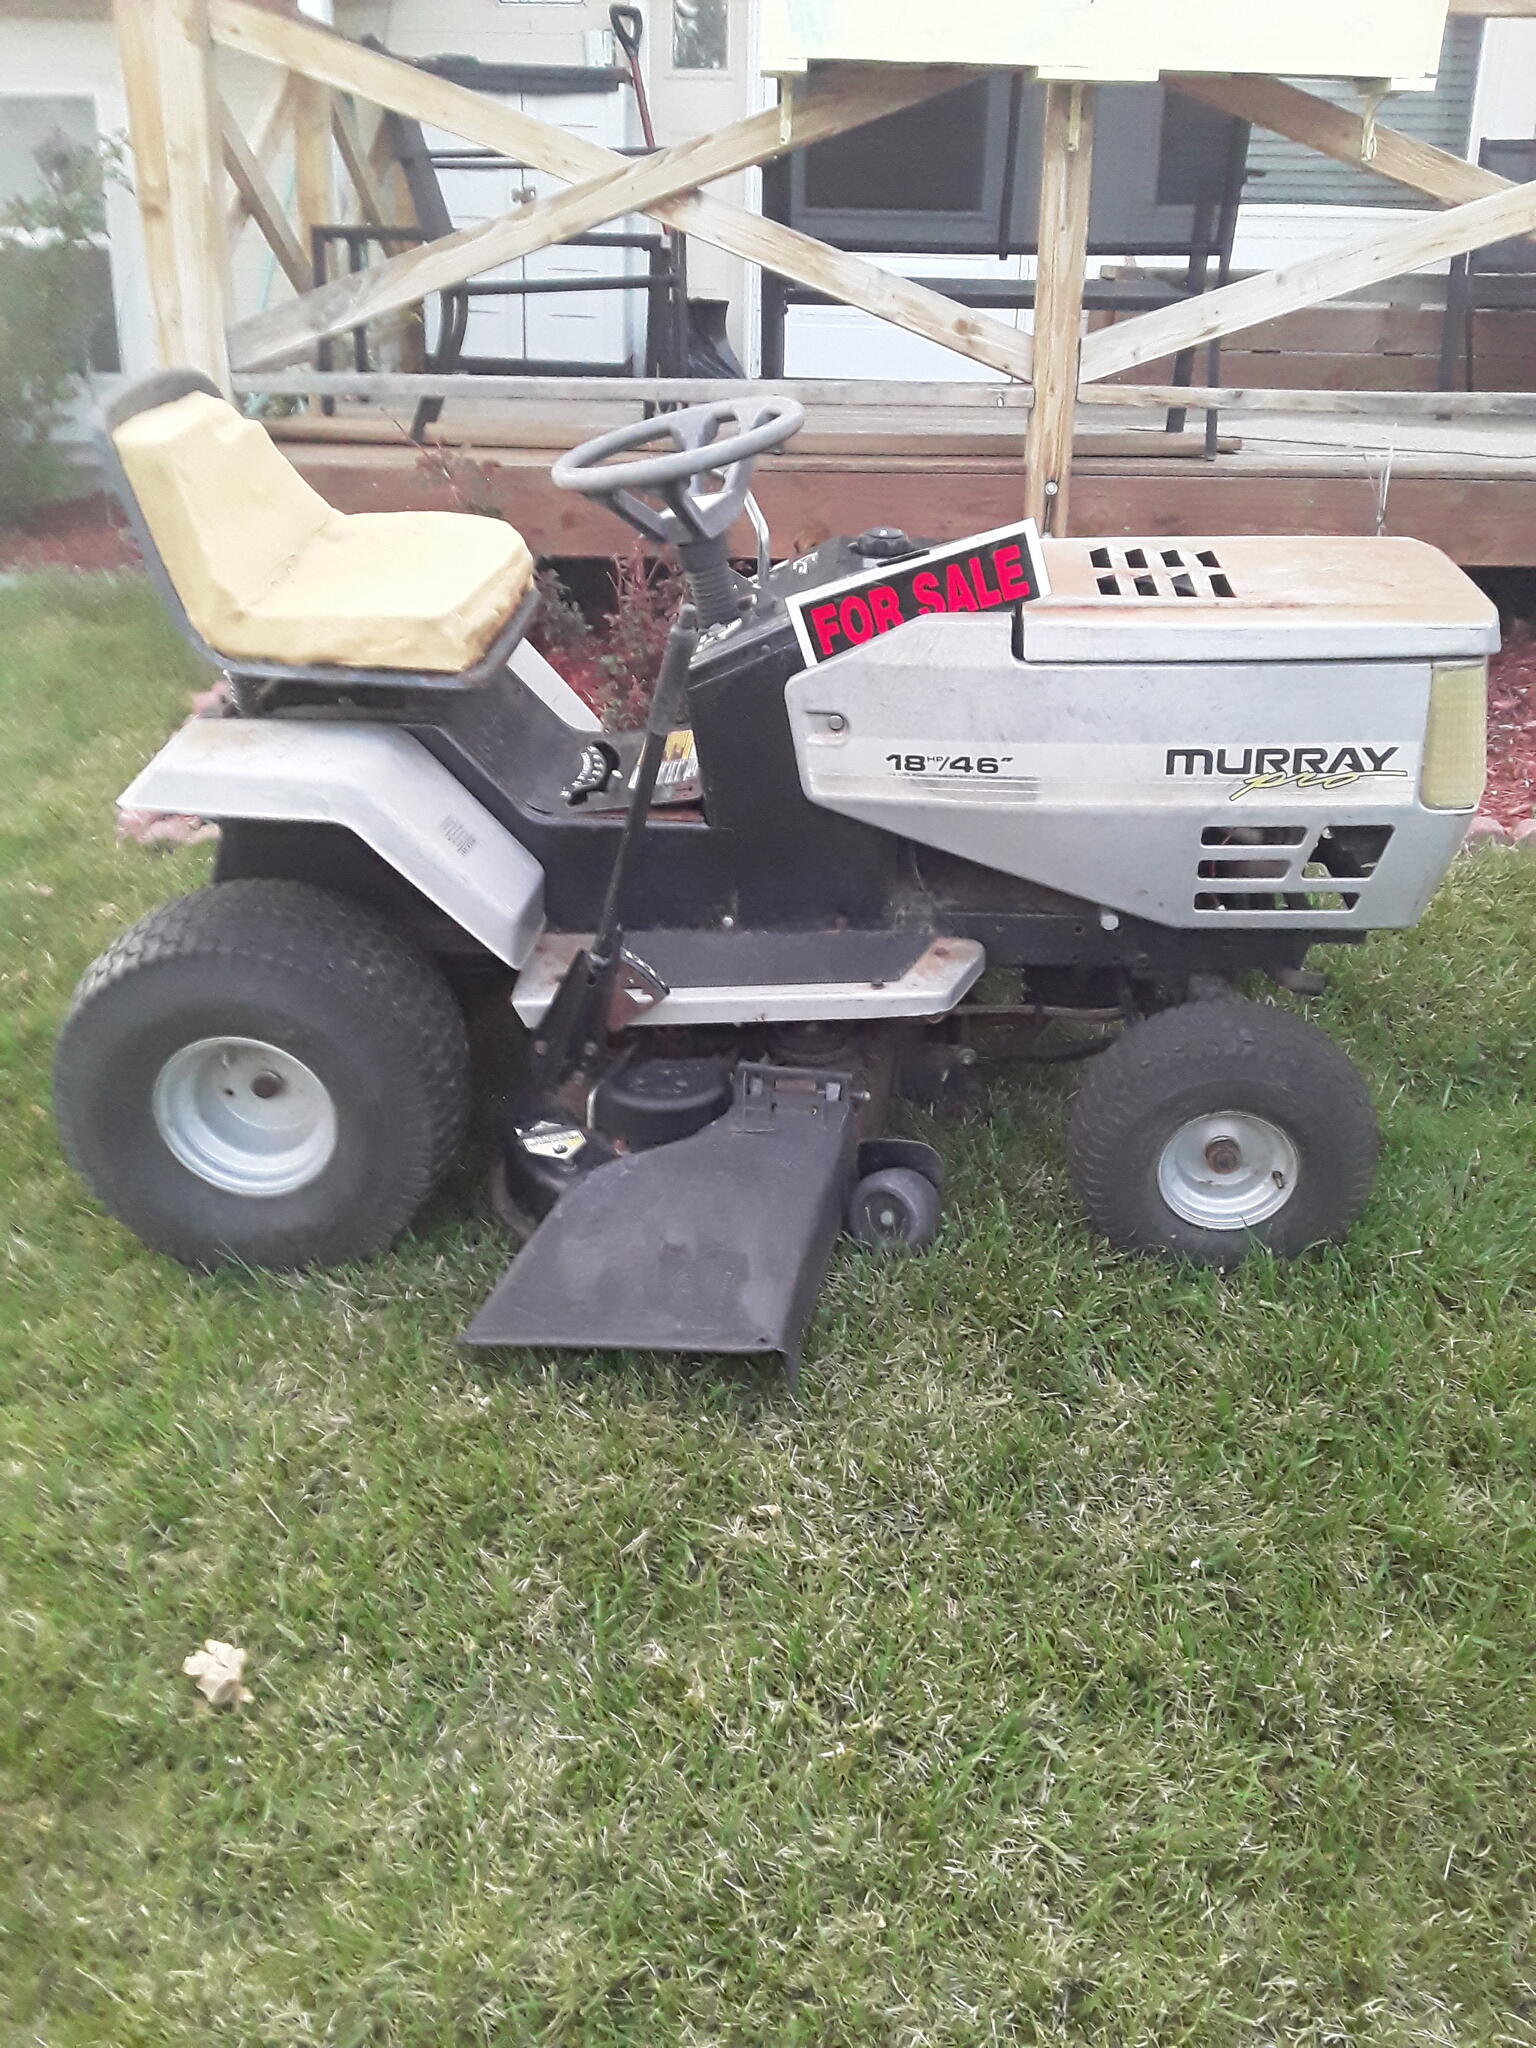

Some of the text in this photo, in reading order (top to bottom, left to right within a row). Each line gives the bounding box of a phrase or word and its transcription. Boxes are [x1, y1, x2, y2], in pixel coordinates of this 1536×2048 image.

[811, 585, 904, 655] FOR
[911, 544, 1030, 613] SALE
[1165, 747, 1400, 775] MURRAY
